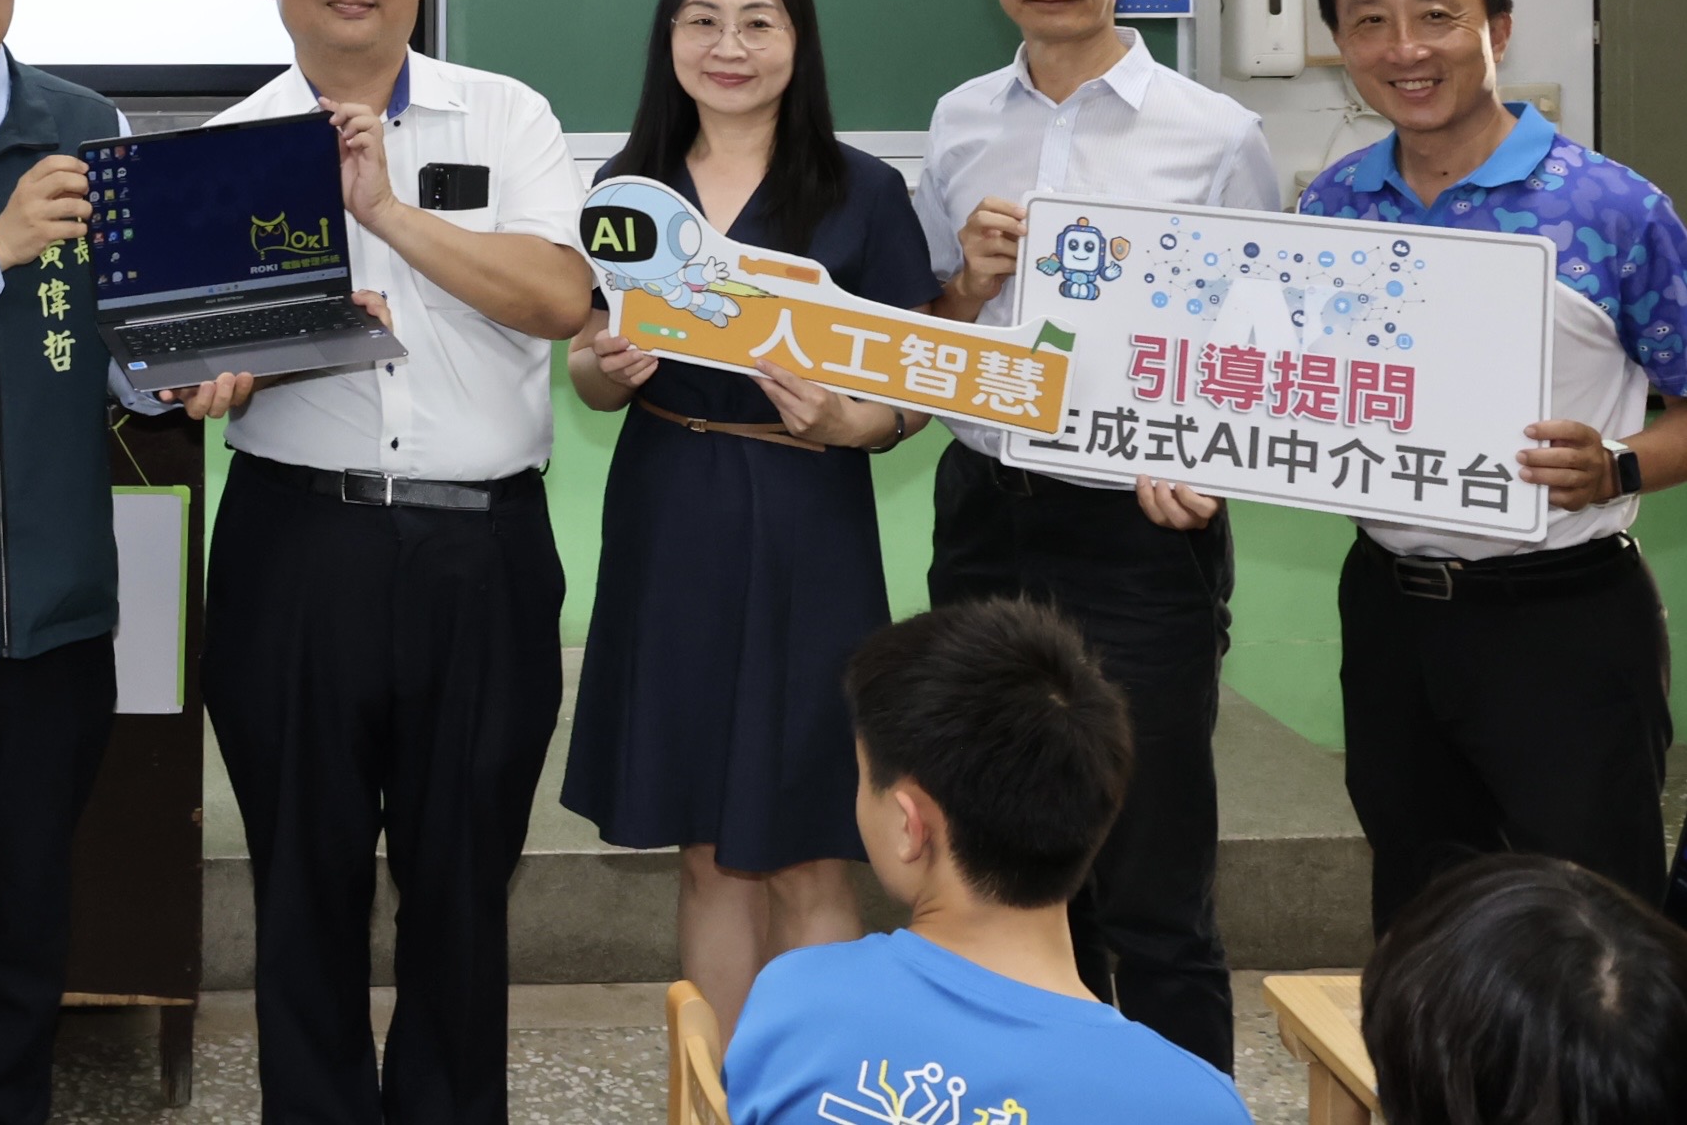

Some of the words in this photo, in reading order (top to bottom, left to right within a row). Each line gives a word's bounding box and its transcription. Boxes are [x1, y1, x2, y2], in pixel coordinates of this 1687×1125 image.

[590, 216, 637, 253] AI
[250, 263, 278, 275] ROKI
[749, 308, 1046, 418] 人工智慧
[1128, 333, 1417, 432] 引導提問
